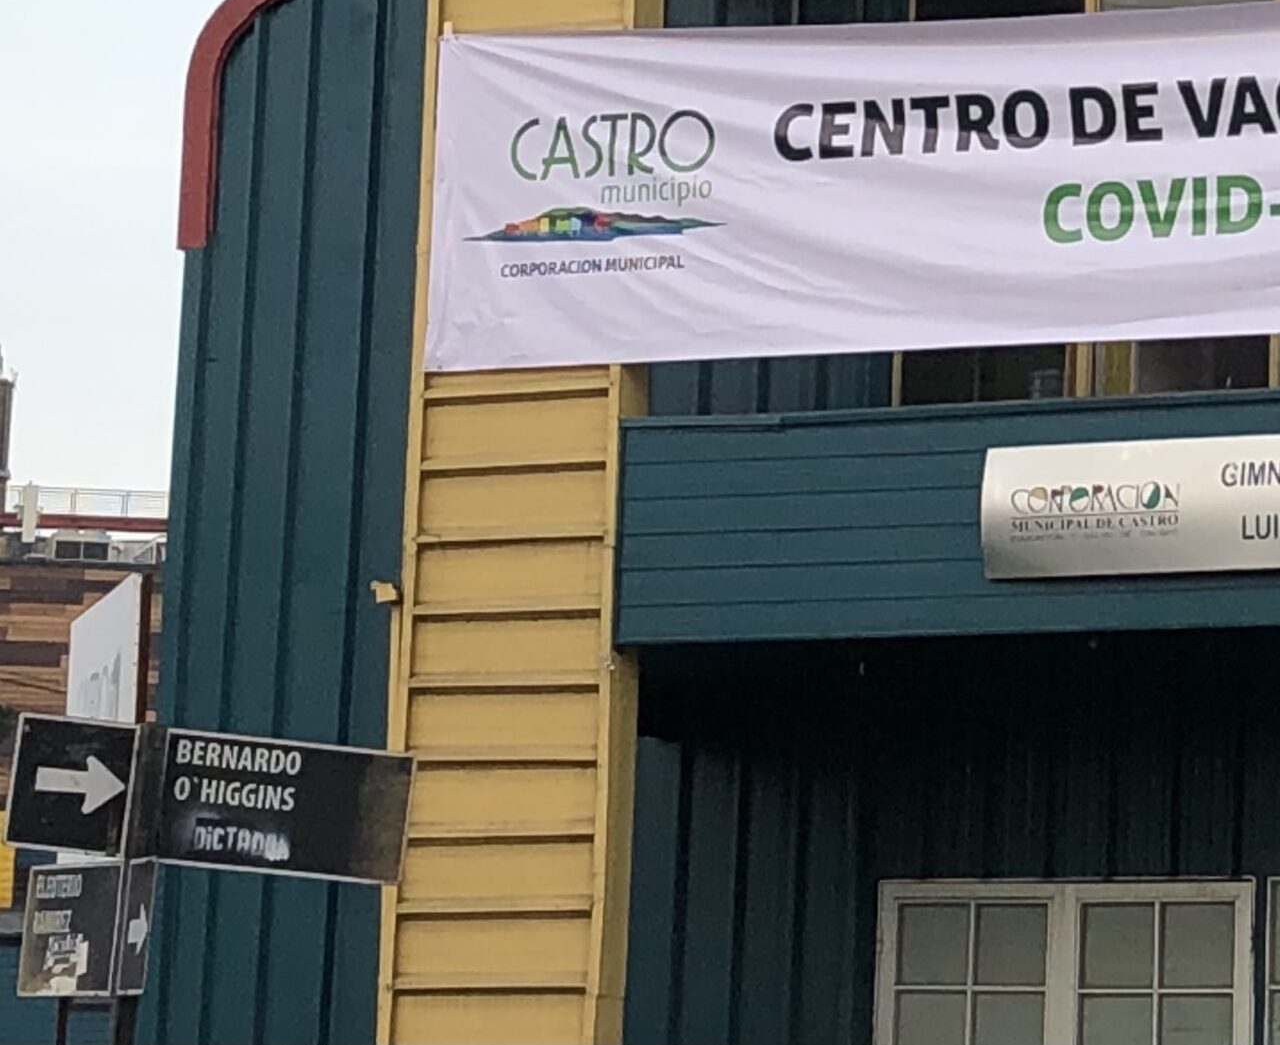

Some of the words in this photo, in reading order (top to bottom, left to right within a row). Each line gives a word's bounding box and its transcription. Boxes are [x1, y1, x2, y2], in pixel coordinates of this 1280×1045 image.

[773, 88, 1049, 163] CENTRO
[1070, 81, 1165, 146] DE
[510, 110, 715, 181] CASTRO
[600, 176, 713, 206] municipio
[500, 258, 601, 277] CORPORACION
[604, 255, 685, 273] MUNICIPAL
[176, 739, 302, 776] BERNARDO
